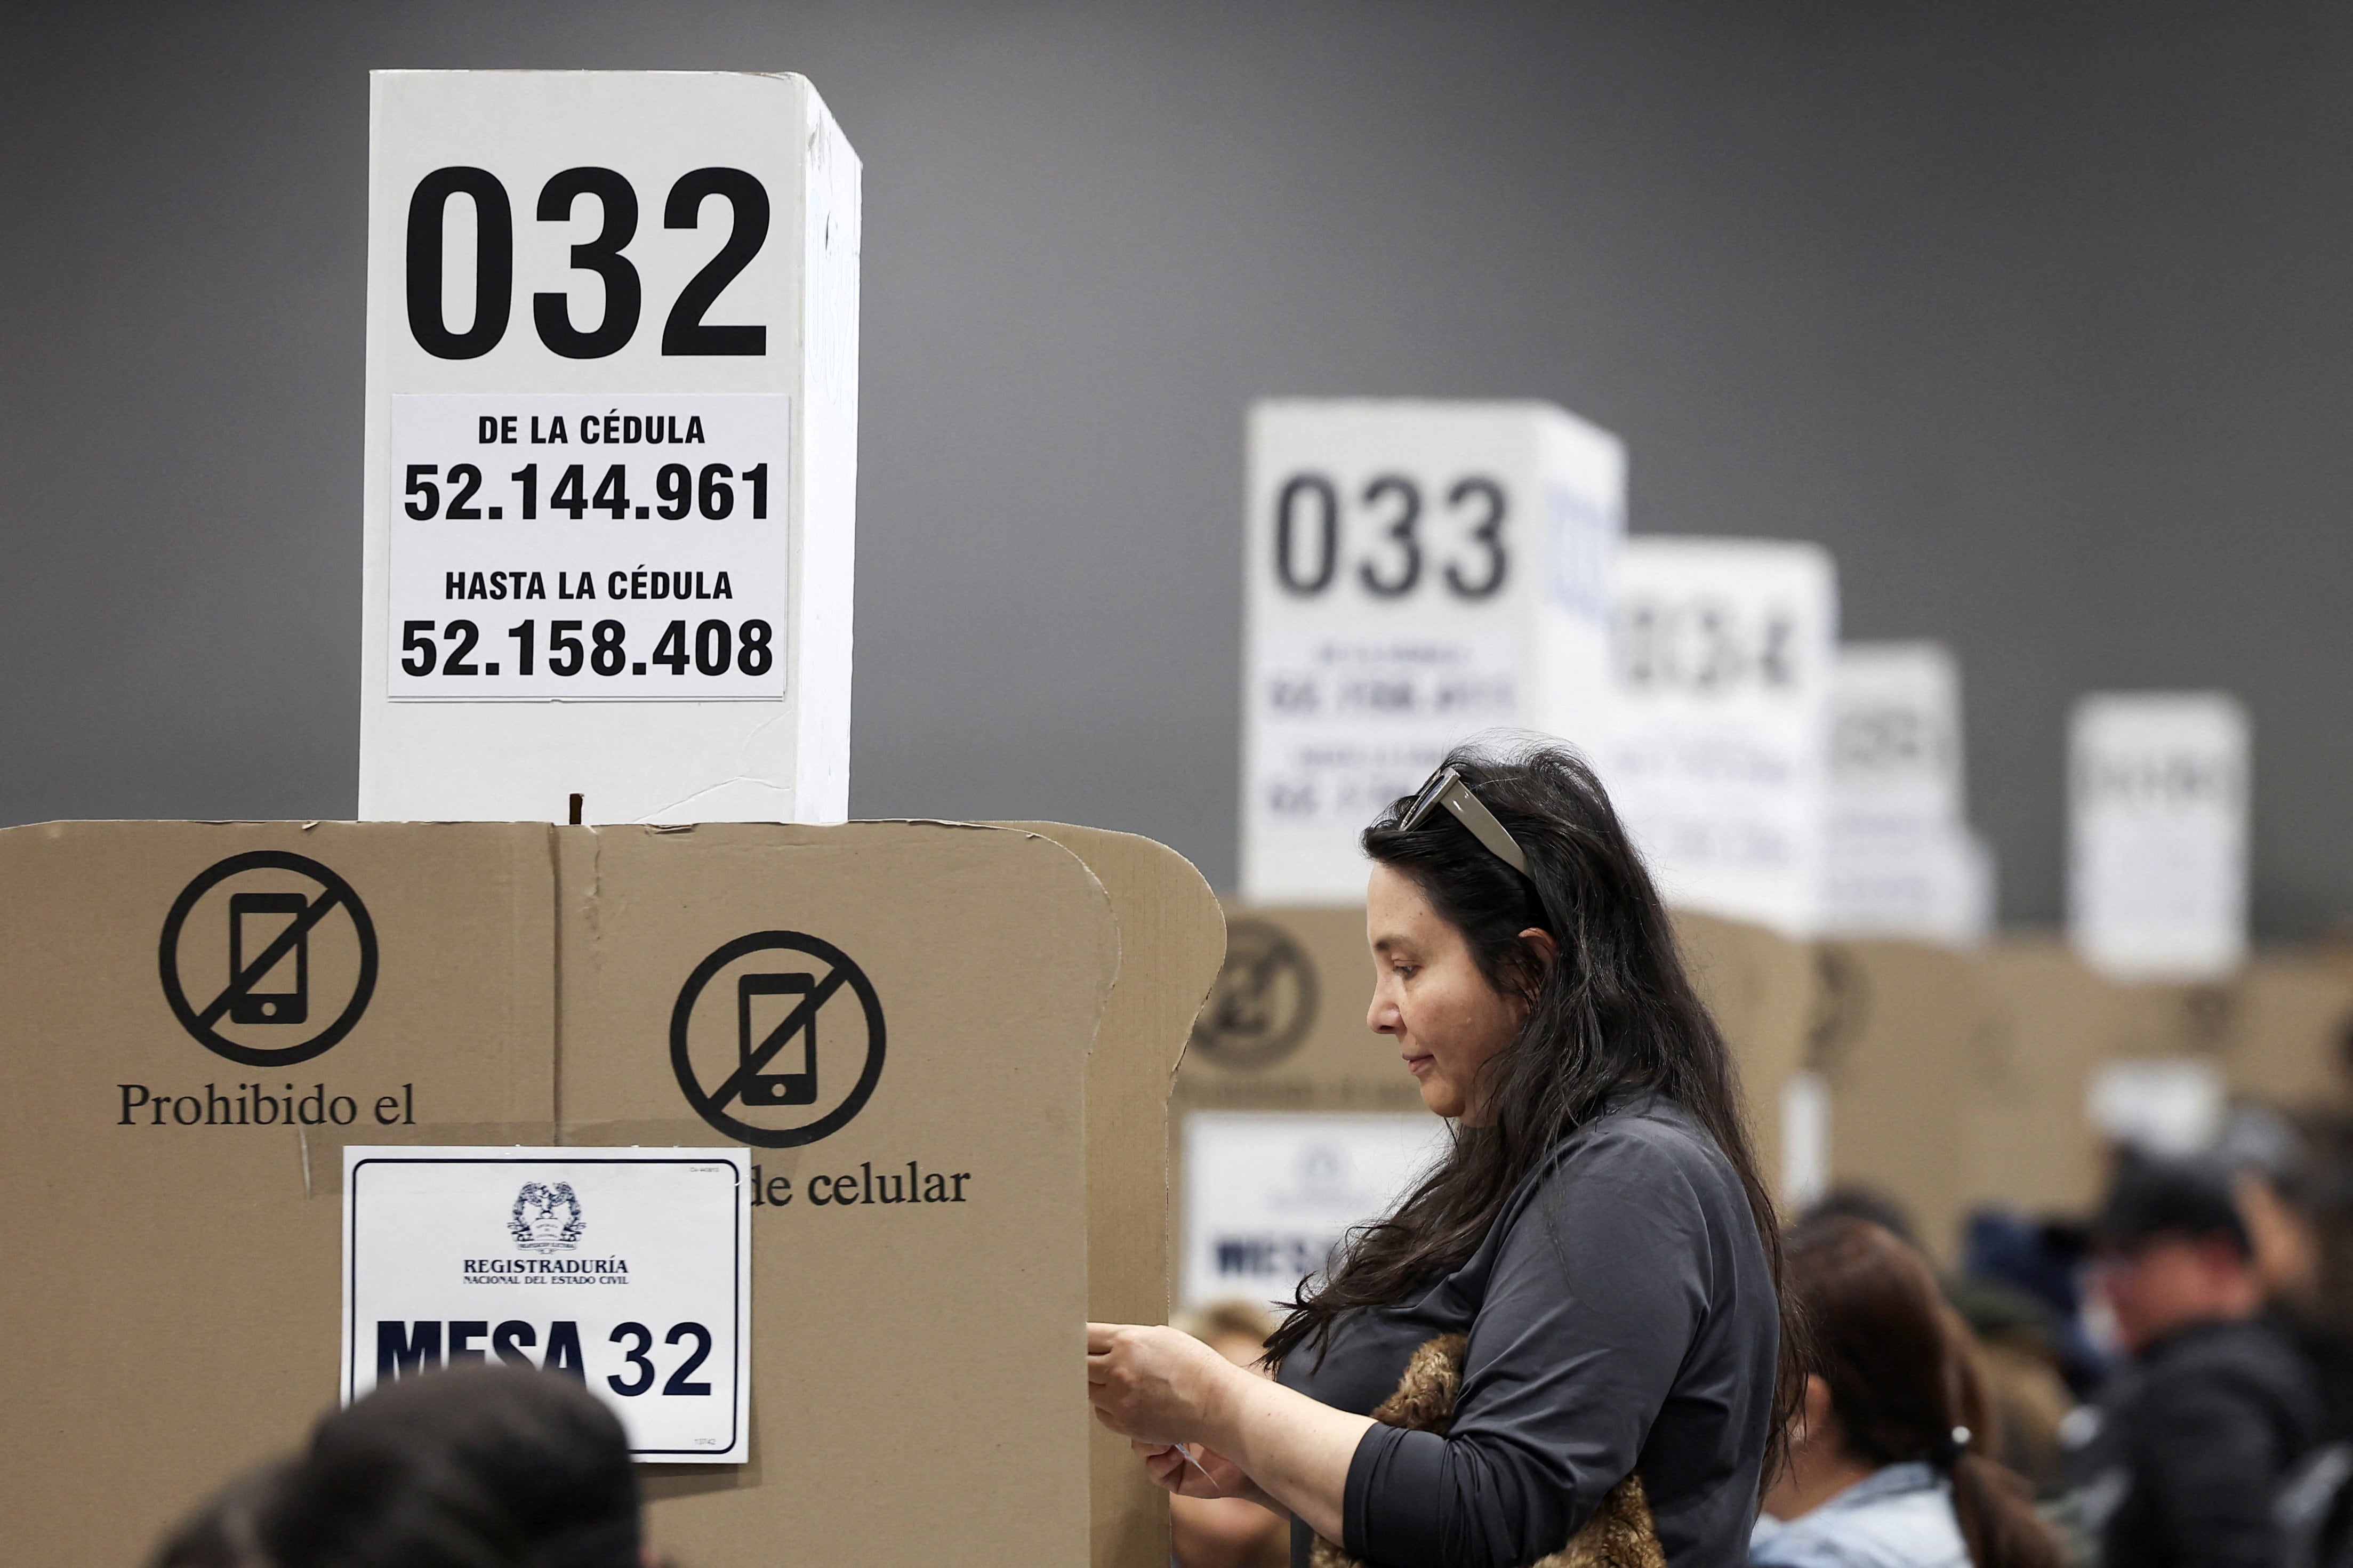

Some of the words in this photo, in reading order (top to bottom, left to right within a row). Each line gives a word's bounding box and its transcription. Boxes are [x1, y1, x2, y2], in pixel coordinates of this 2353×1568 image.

[405, 165, 770, 360] 032
[479, 416, 517, 445] DE
[531, 416, 568, 445] LA
[580, 408, 705, 445] CÉDULA
[404, 463, 767, 521] 52.144.961
[1273, 473, 1508, 600] 033
[446, 572, 546, 600] HASTA
[559, 572, 596, 600] LA
[608, 564, 733, 600] CÉDULA
[401, 619, 773, 677] 52.158.408
[117, 1084, 357, 1125] Prohibido
[374, 1083, 416, 1125] el
[808, 1161, 971, 1206] celular
[463, 1255, 629, 1273] REGISTRADURÍA
[463, 1276, 520, 1284] NACIONAL
[524, 1276, 547, 1284] DEL
[551, 1276, 596, 1284] ESTADO
[599, 1276, 629, 1284] CIVIL
[607, 1322, 712, 1397] 32
